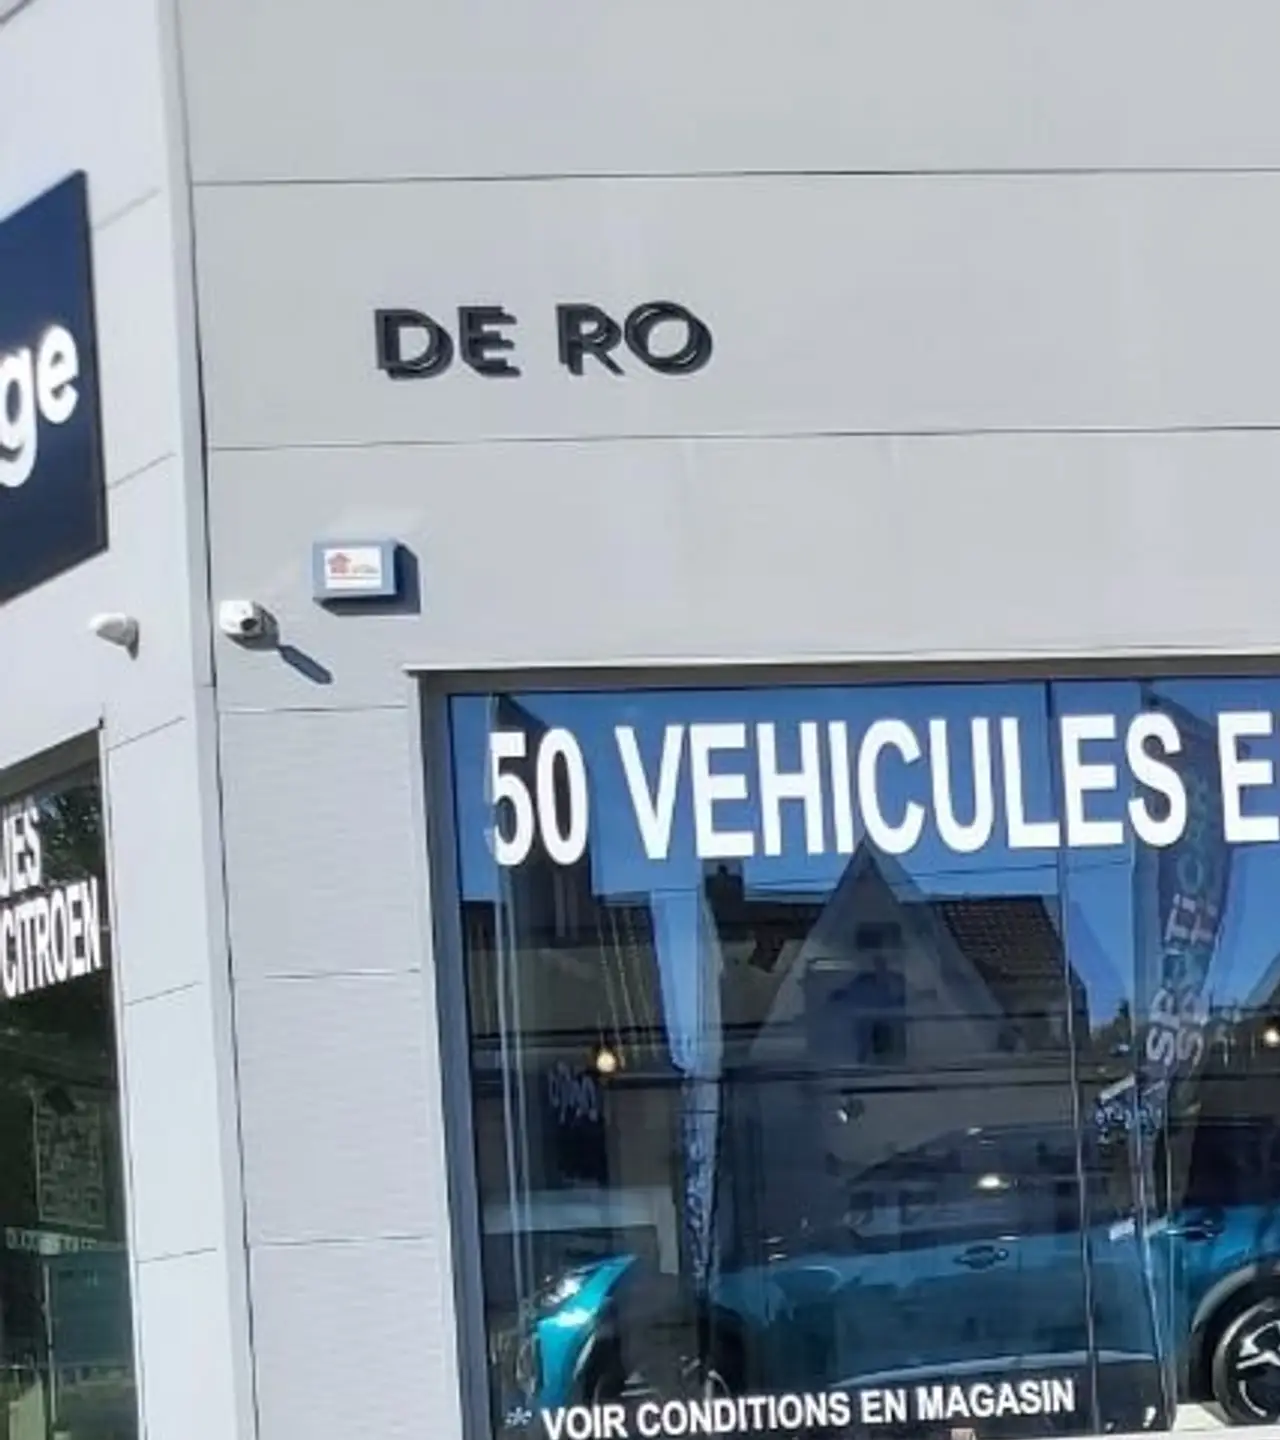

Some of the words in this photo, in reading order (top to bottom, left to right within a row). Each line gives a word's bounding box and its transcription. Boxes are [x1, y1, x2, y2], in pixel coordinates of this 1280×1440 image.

[374, 305, 520, 379] DE
[556, 300, 713, 375] RO
[487, 727, 589, 866] 50
[616, 713, 1188, 859] VEHICULES
[2, 876, 101, 998] CITROEN
[636, 1390, 849, 1438] CONDITIONS
[860, 1387, 907, 1424] EN
[917, 1379, 1076, 1420] MAGASIN
